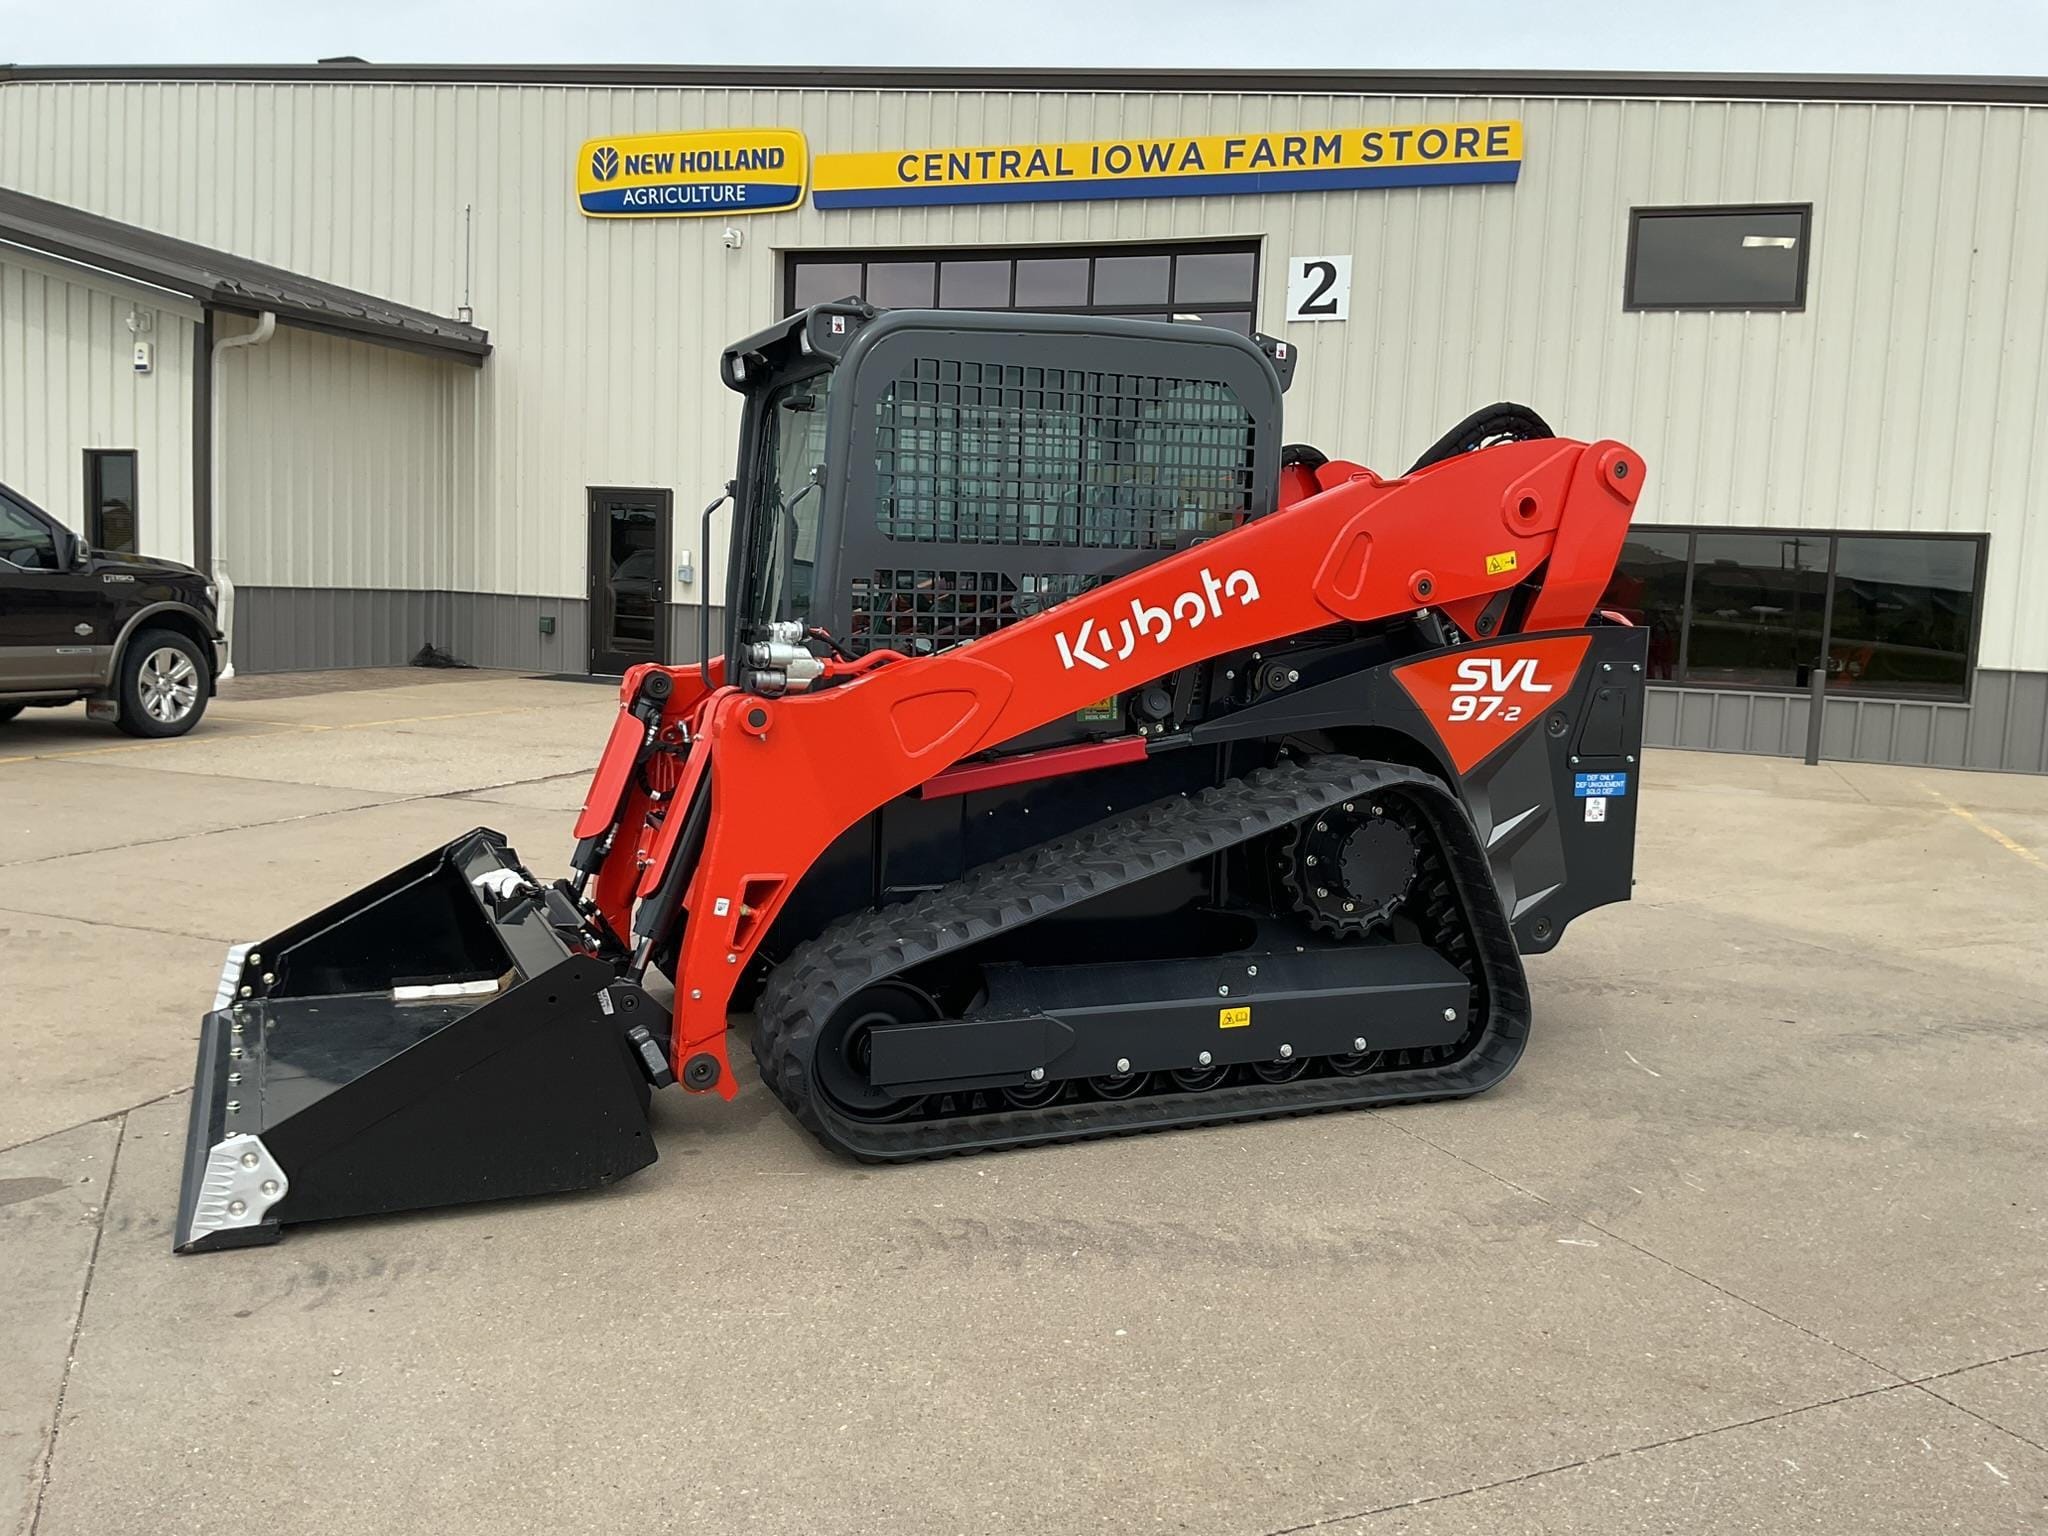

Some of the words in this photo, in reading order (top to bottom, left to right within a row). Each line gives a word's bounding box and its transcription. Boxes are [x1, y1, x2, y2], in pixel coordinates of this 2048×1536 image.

[625, 153, 675, 175] NEW
[680, 147, 785, 173] HOLLAND
[897, 148, 1074, 182] CENTRAL
[1091, 141, 1206, 173] IOWA
[1224, 134, 1343, 169] FARM
[1360, 125, 1511, 162] STORE
[623, 185, 746, 206] AGRICULTURE
[1298, 261, 1338, 315] 2
[1054, 568, 1260, 670] Kubota
[1449, 658, 1553, 692] SVL
[1448, 695, 1522, 721] 97-2
